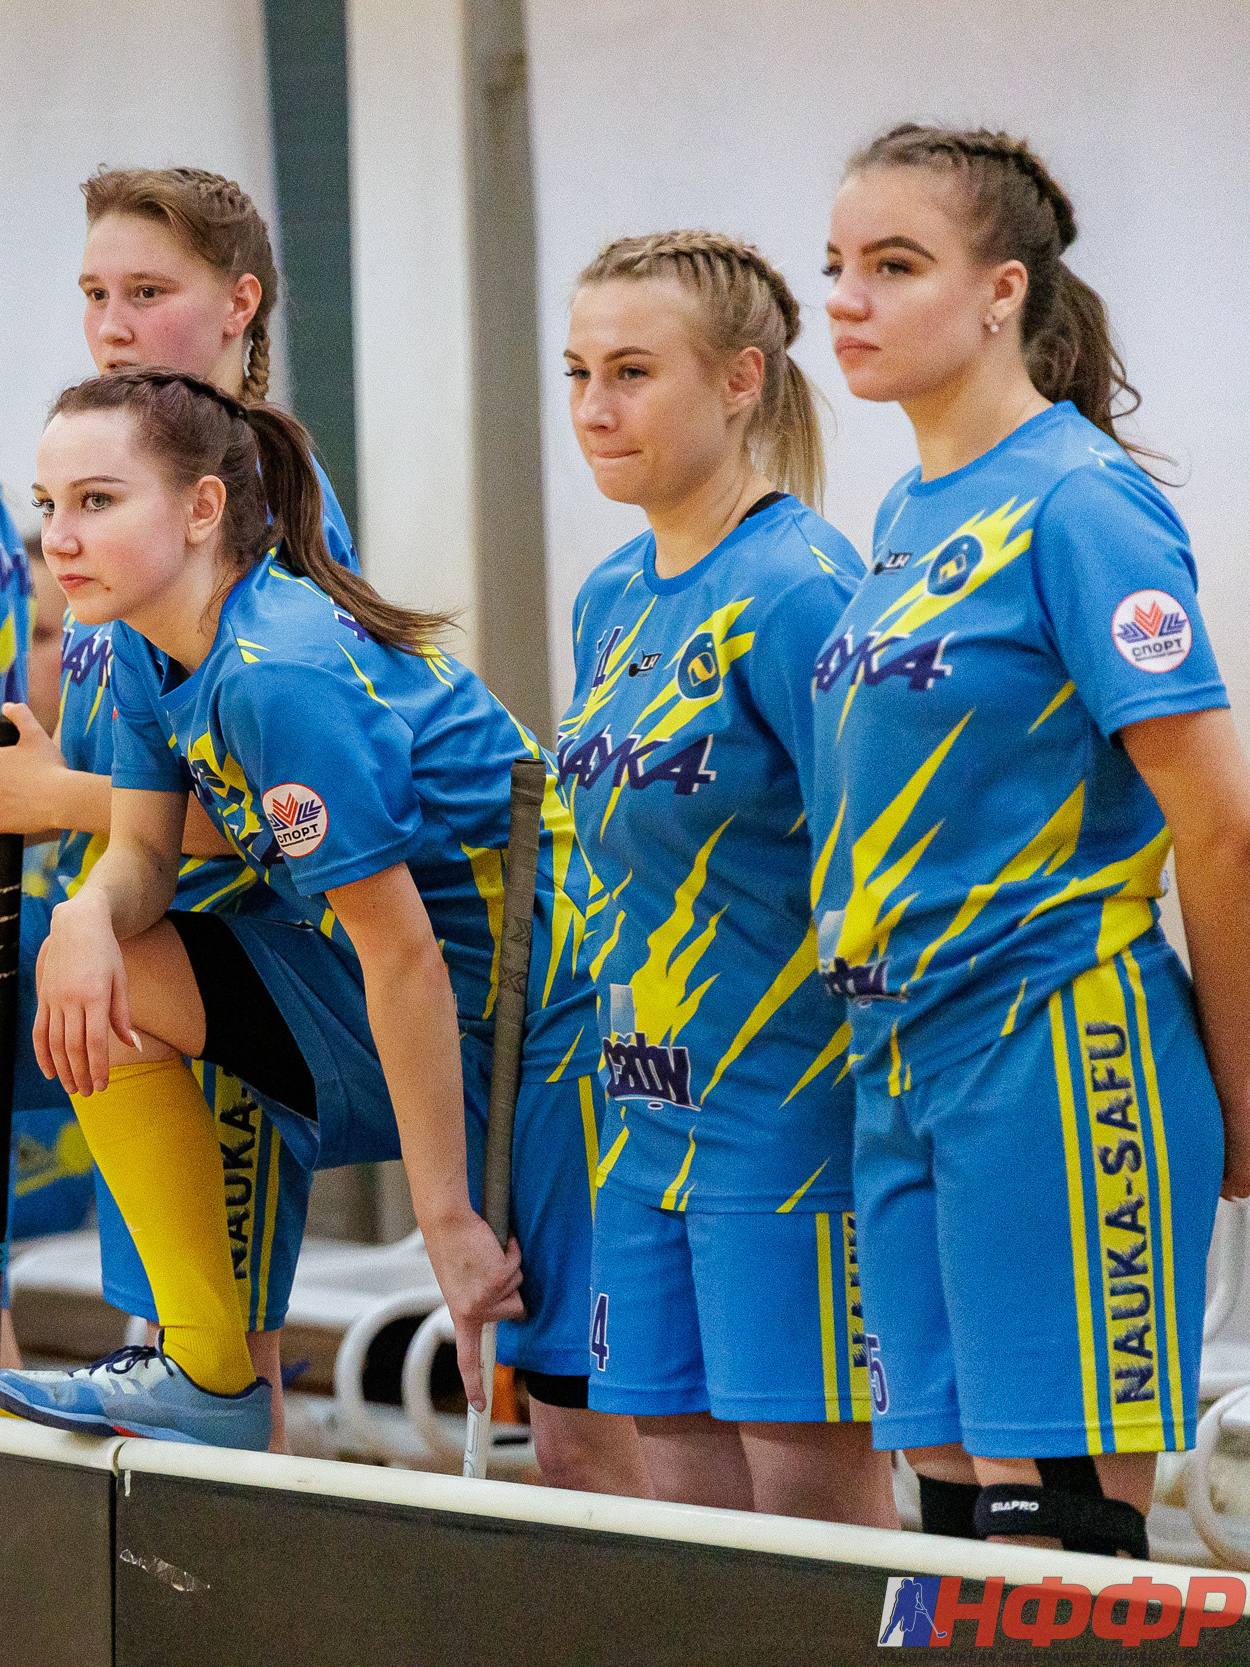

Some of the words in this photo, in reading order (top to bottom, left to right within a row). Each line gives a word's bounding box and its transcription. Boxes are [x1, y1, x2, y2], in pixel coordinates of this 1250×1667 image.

[1132, 637, 1182, 657] СПОРТ
[277, 823, 318, 844] СПОРТ
[1084, 1020, 1156, 1405] NAUKA-SAFU
